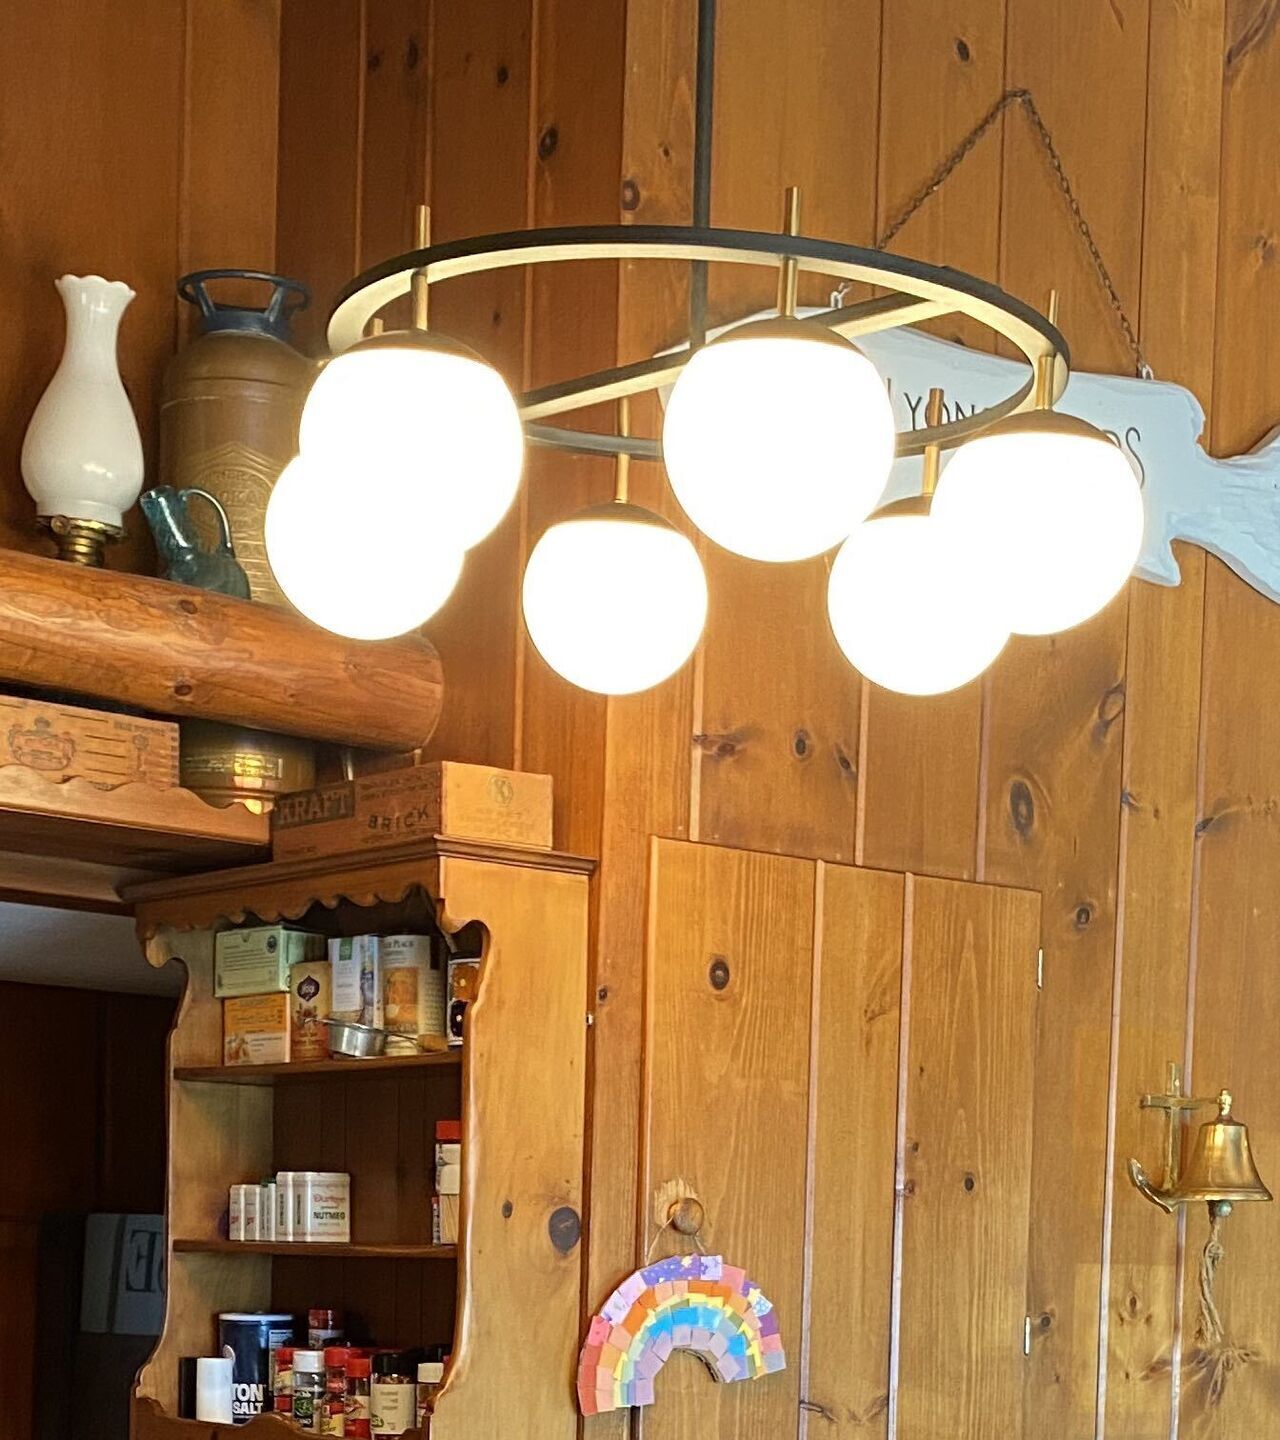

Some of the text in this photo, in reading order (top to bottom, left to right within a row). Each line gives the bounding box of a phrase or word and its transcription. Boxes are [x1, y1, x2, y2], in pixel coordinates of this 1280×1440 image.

[277, 787, 351, 825] KRAFT
[367, 804, 429, 833] BRICK
[232, 1383, 264, 1402] TON
[232, 1402, 263, 1415] SALT
